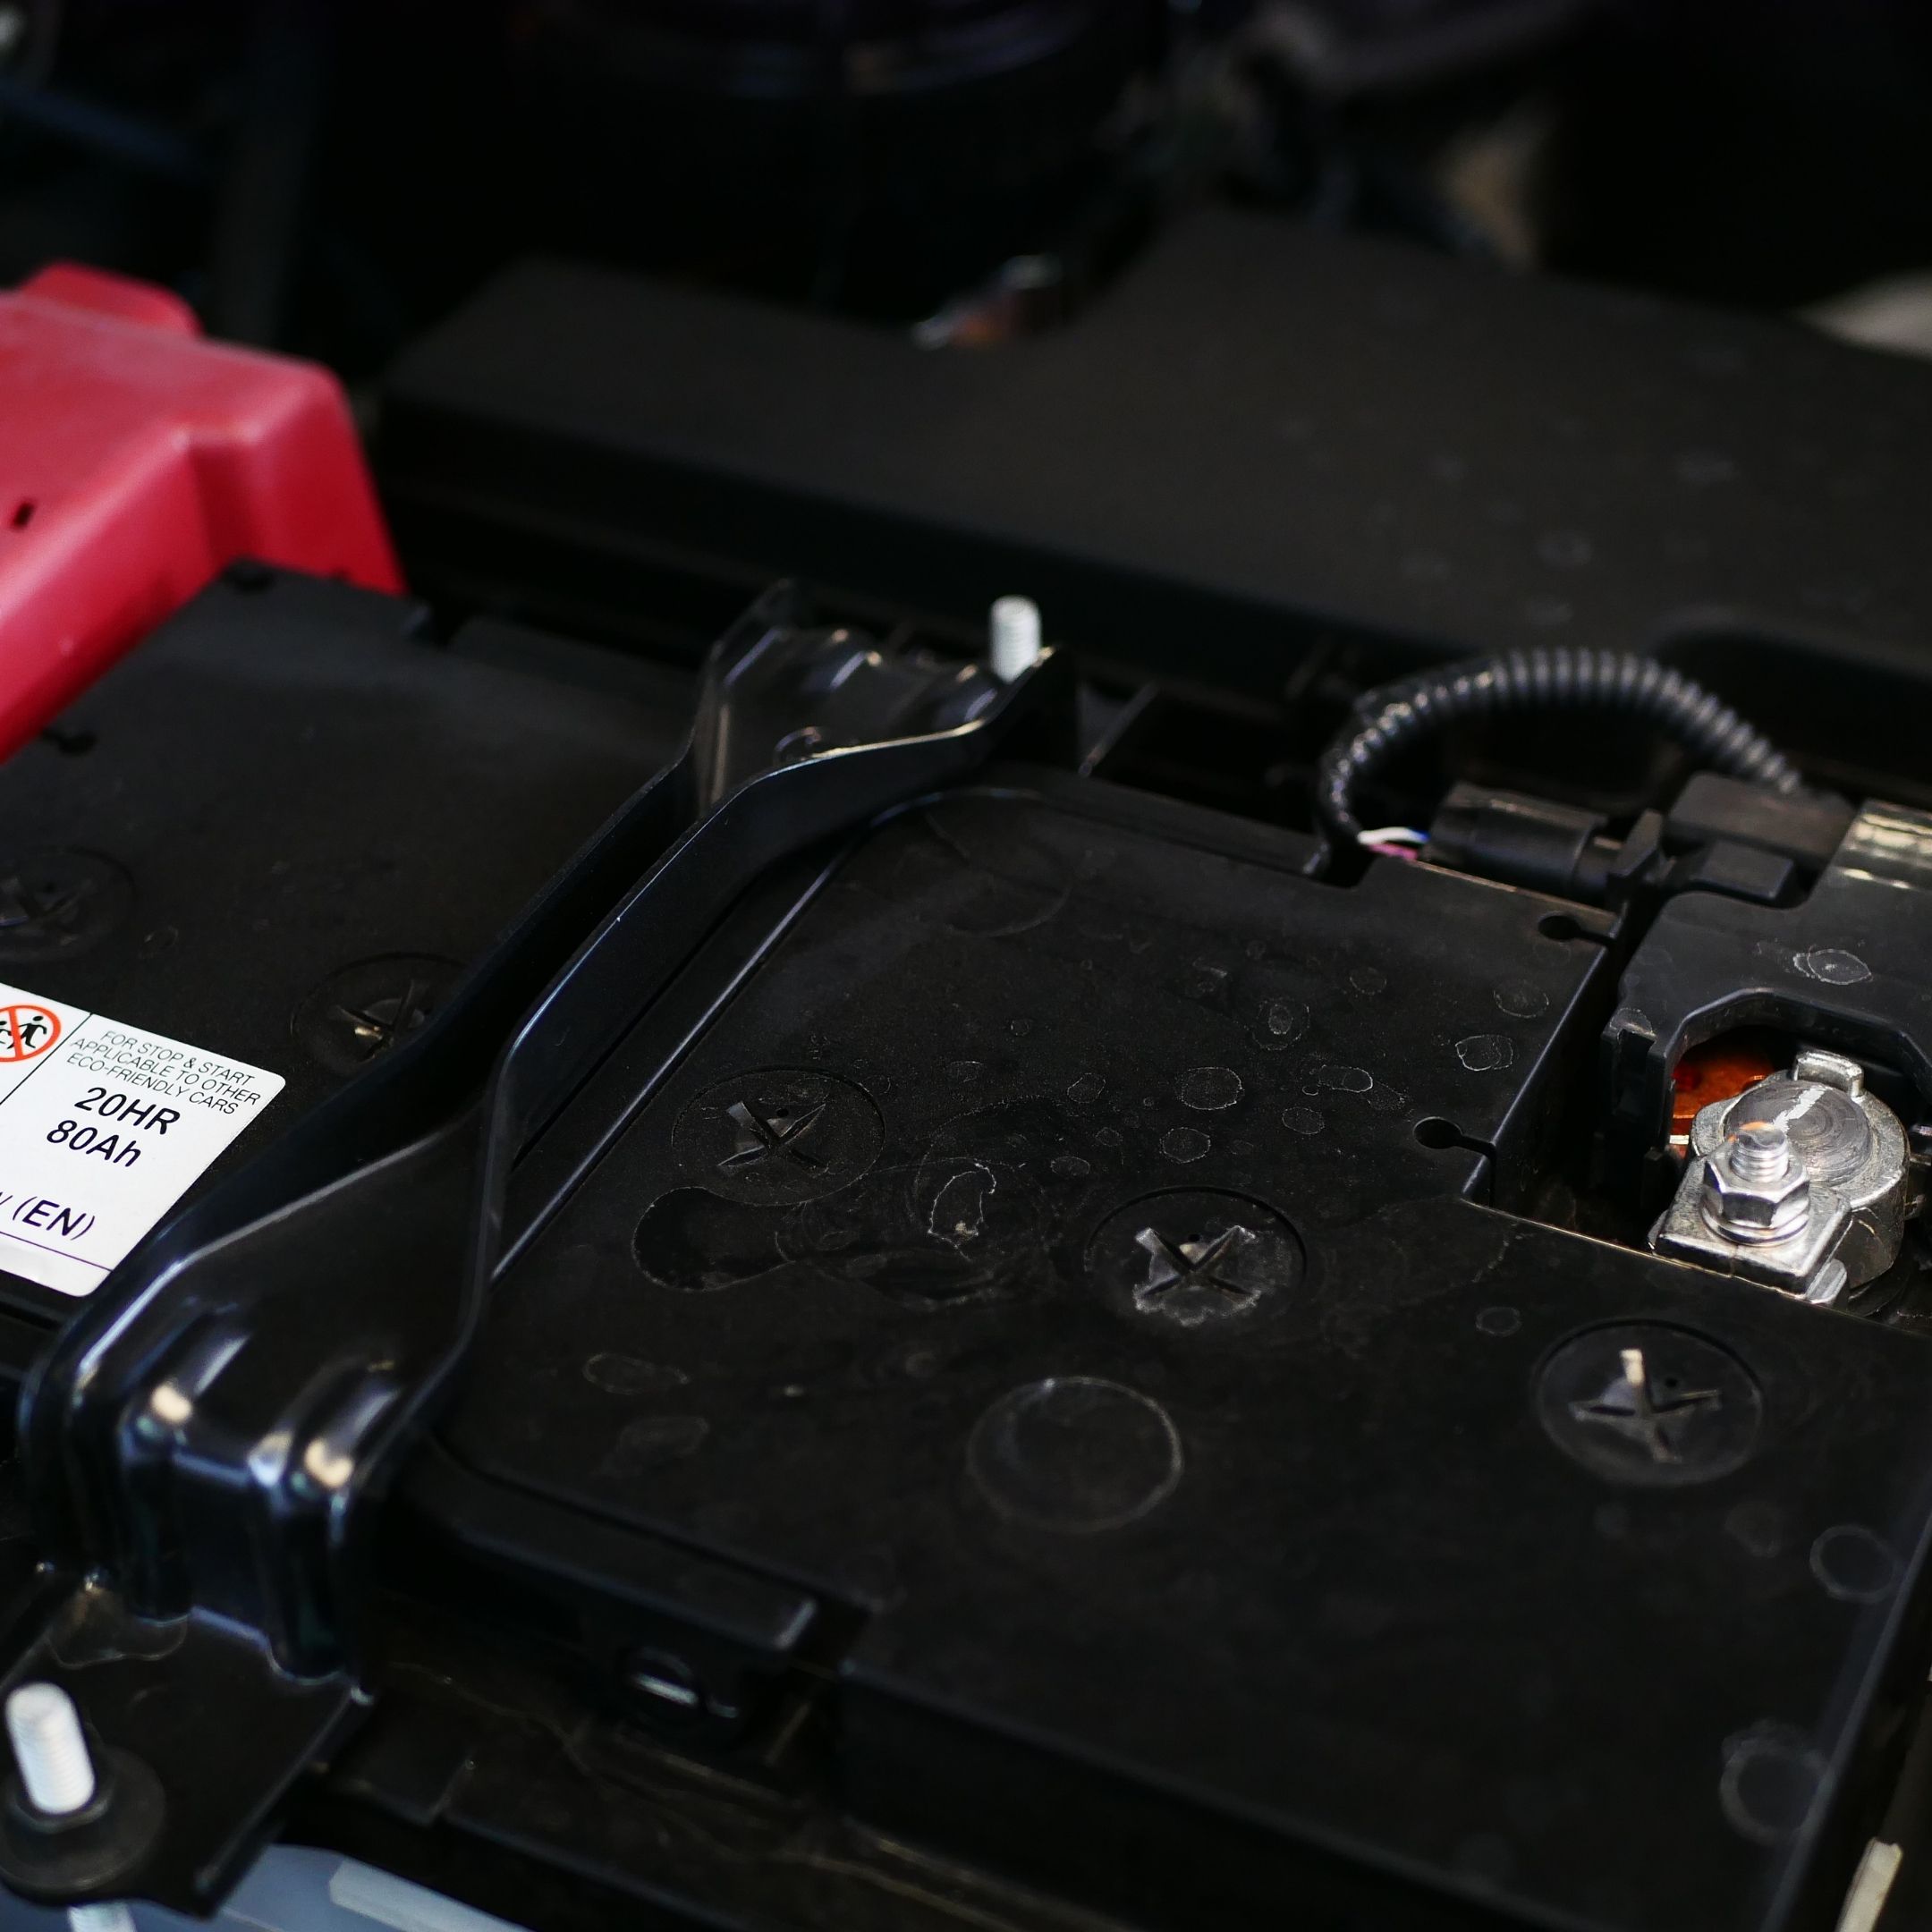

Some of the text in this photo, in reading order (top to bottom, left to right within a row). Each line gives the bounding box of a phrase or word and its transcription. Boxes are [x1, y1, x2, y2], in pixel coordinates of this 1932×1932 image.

[66, 1053, 239, 1114] ECO-FRIENDLY CARS
[70, 1038, 261, 1106] APPLICABLE TO OTHER
[100, 1031, 255, 1086] FOR STOP & START
[74, 1087, 181, 1135] 20HR
[47, 1120, 141, 1167] 80Ah
[13, 1196, 95, 1241] (EN)
